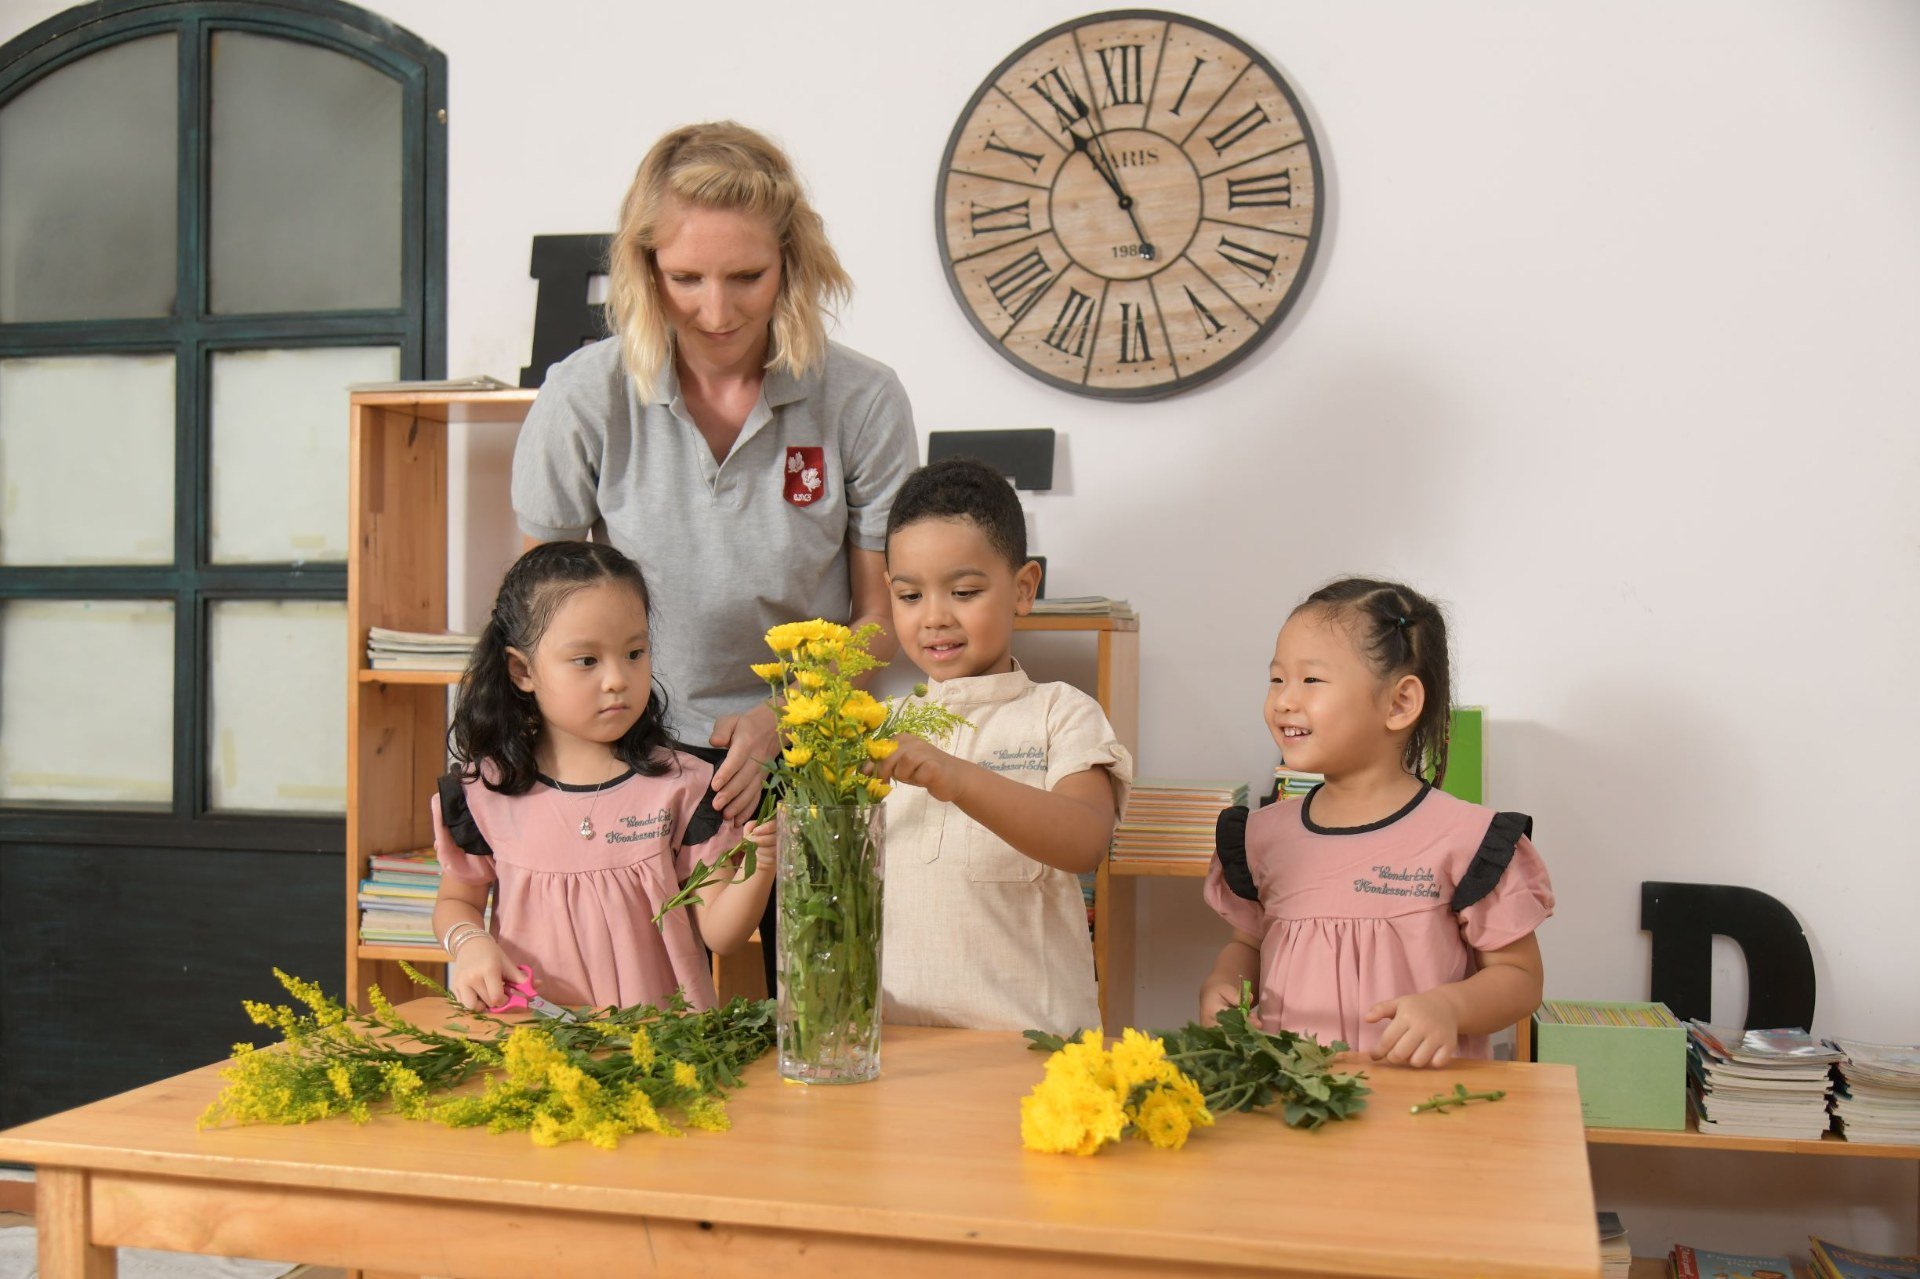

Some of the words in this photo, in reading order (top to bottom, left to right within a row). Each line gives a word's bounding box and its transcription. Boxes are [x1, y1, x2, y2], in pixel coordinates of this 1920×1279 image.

[1095, 44, 1146, 110] XII
[983, 129, 1046, 174] X
[1206, 102, 1271, 158] II
[1226, 167, 1292, 212] III
[970, 197, 1032, 239] IX
[1111, 243, 1150, 260] 198
[1116, 301, 1155, 364] VI
